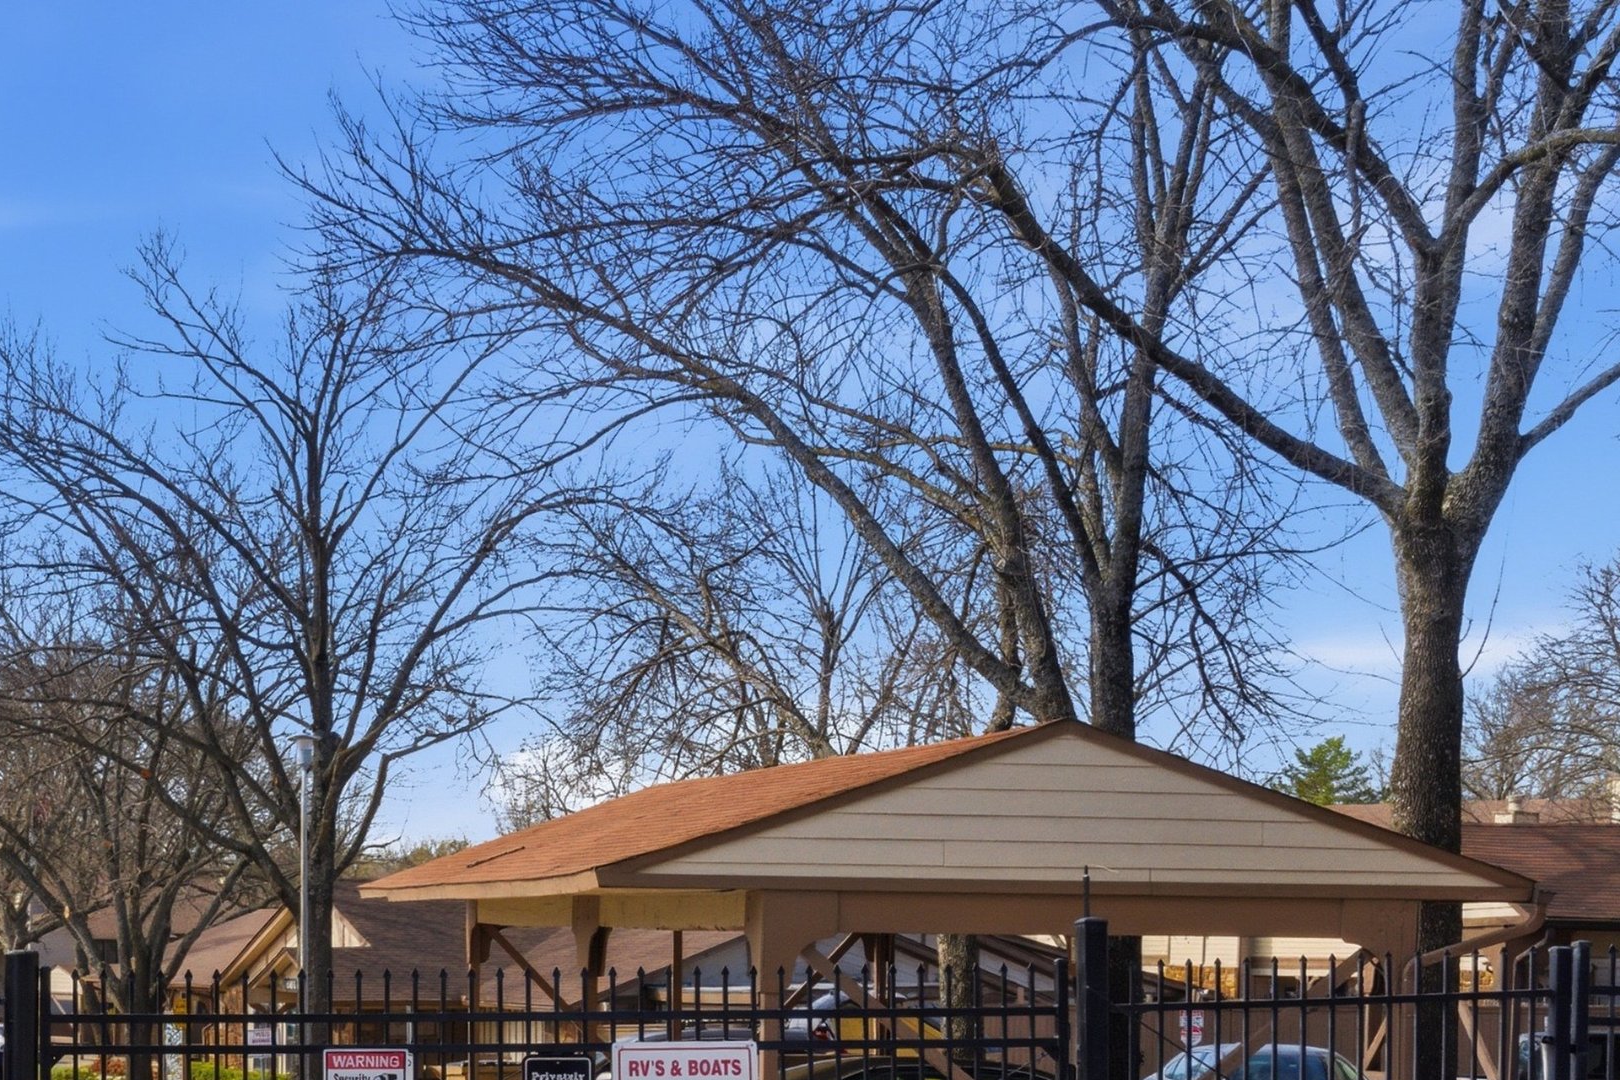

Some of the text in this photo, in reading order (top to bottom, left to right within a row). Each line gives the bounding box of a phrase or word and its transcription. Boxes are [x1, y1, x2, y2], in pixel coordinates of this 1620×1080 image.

[332, 1056, 400, 1067] WARNING
[629, 1060, 742, 1077] RV'S & BOATS
